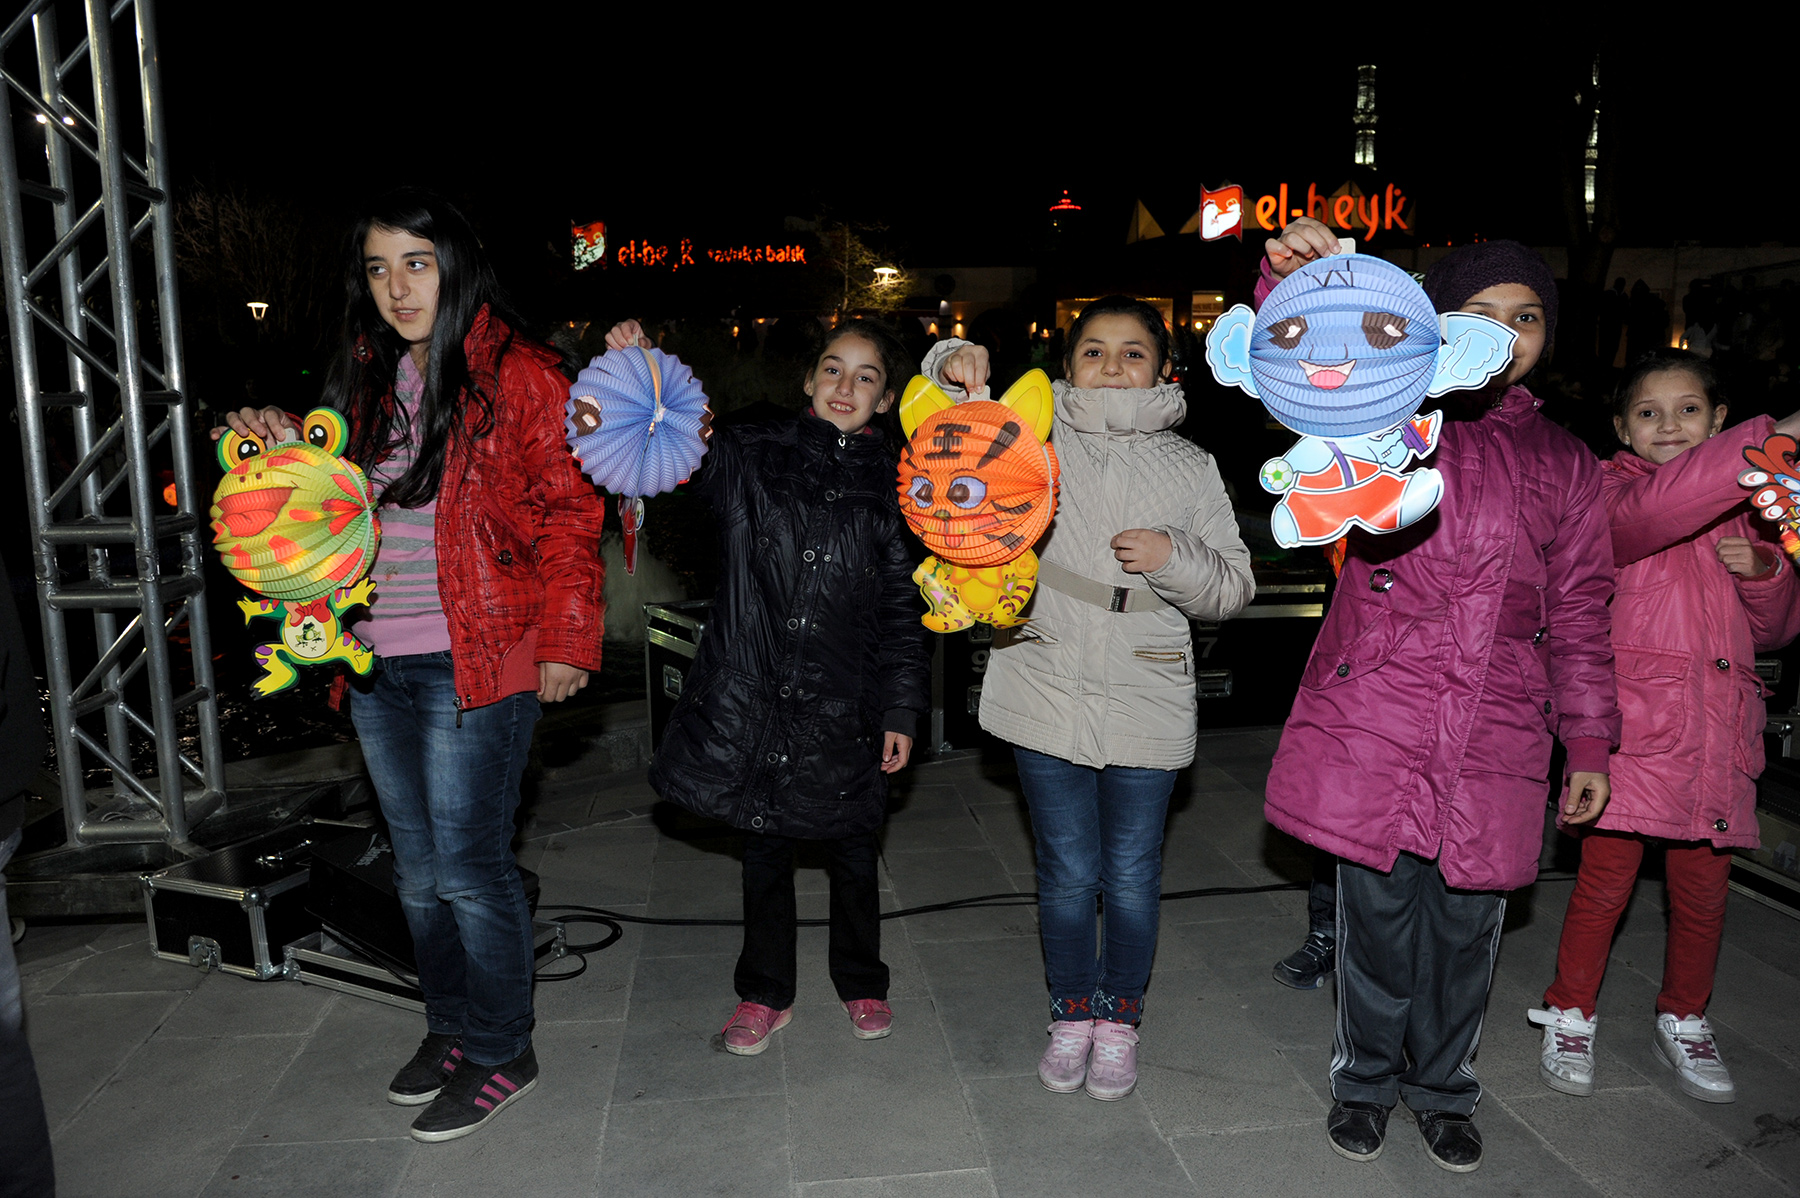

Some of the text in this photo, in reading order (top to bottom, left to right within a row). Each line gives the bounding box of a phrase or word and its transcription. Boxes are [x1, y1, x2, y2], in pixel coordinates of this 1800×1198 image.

[1255, 182, 1409, 242] el-beyk
[617, 238, 695, 272] el-bek
[970, 650, 990, 673] 9
[1199, 636, 1218, 659] 7
